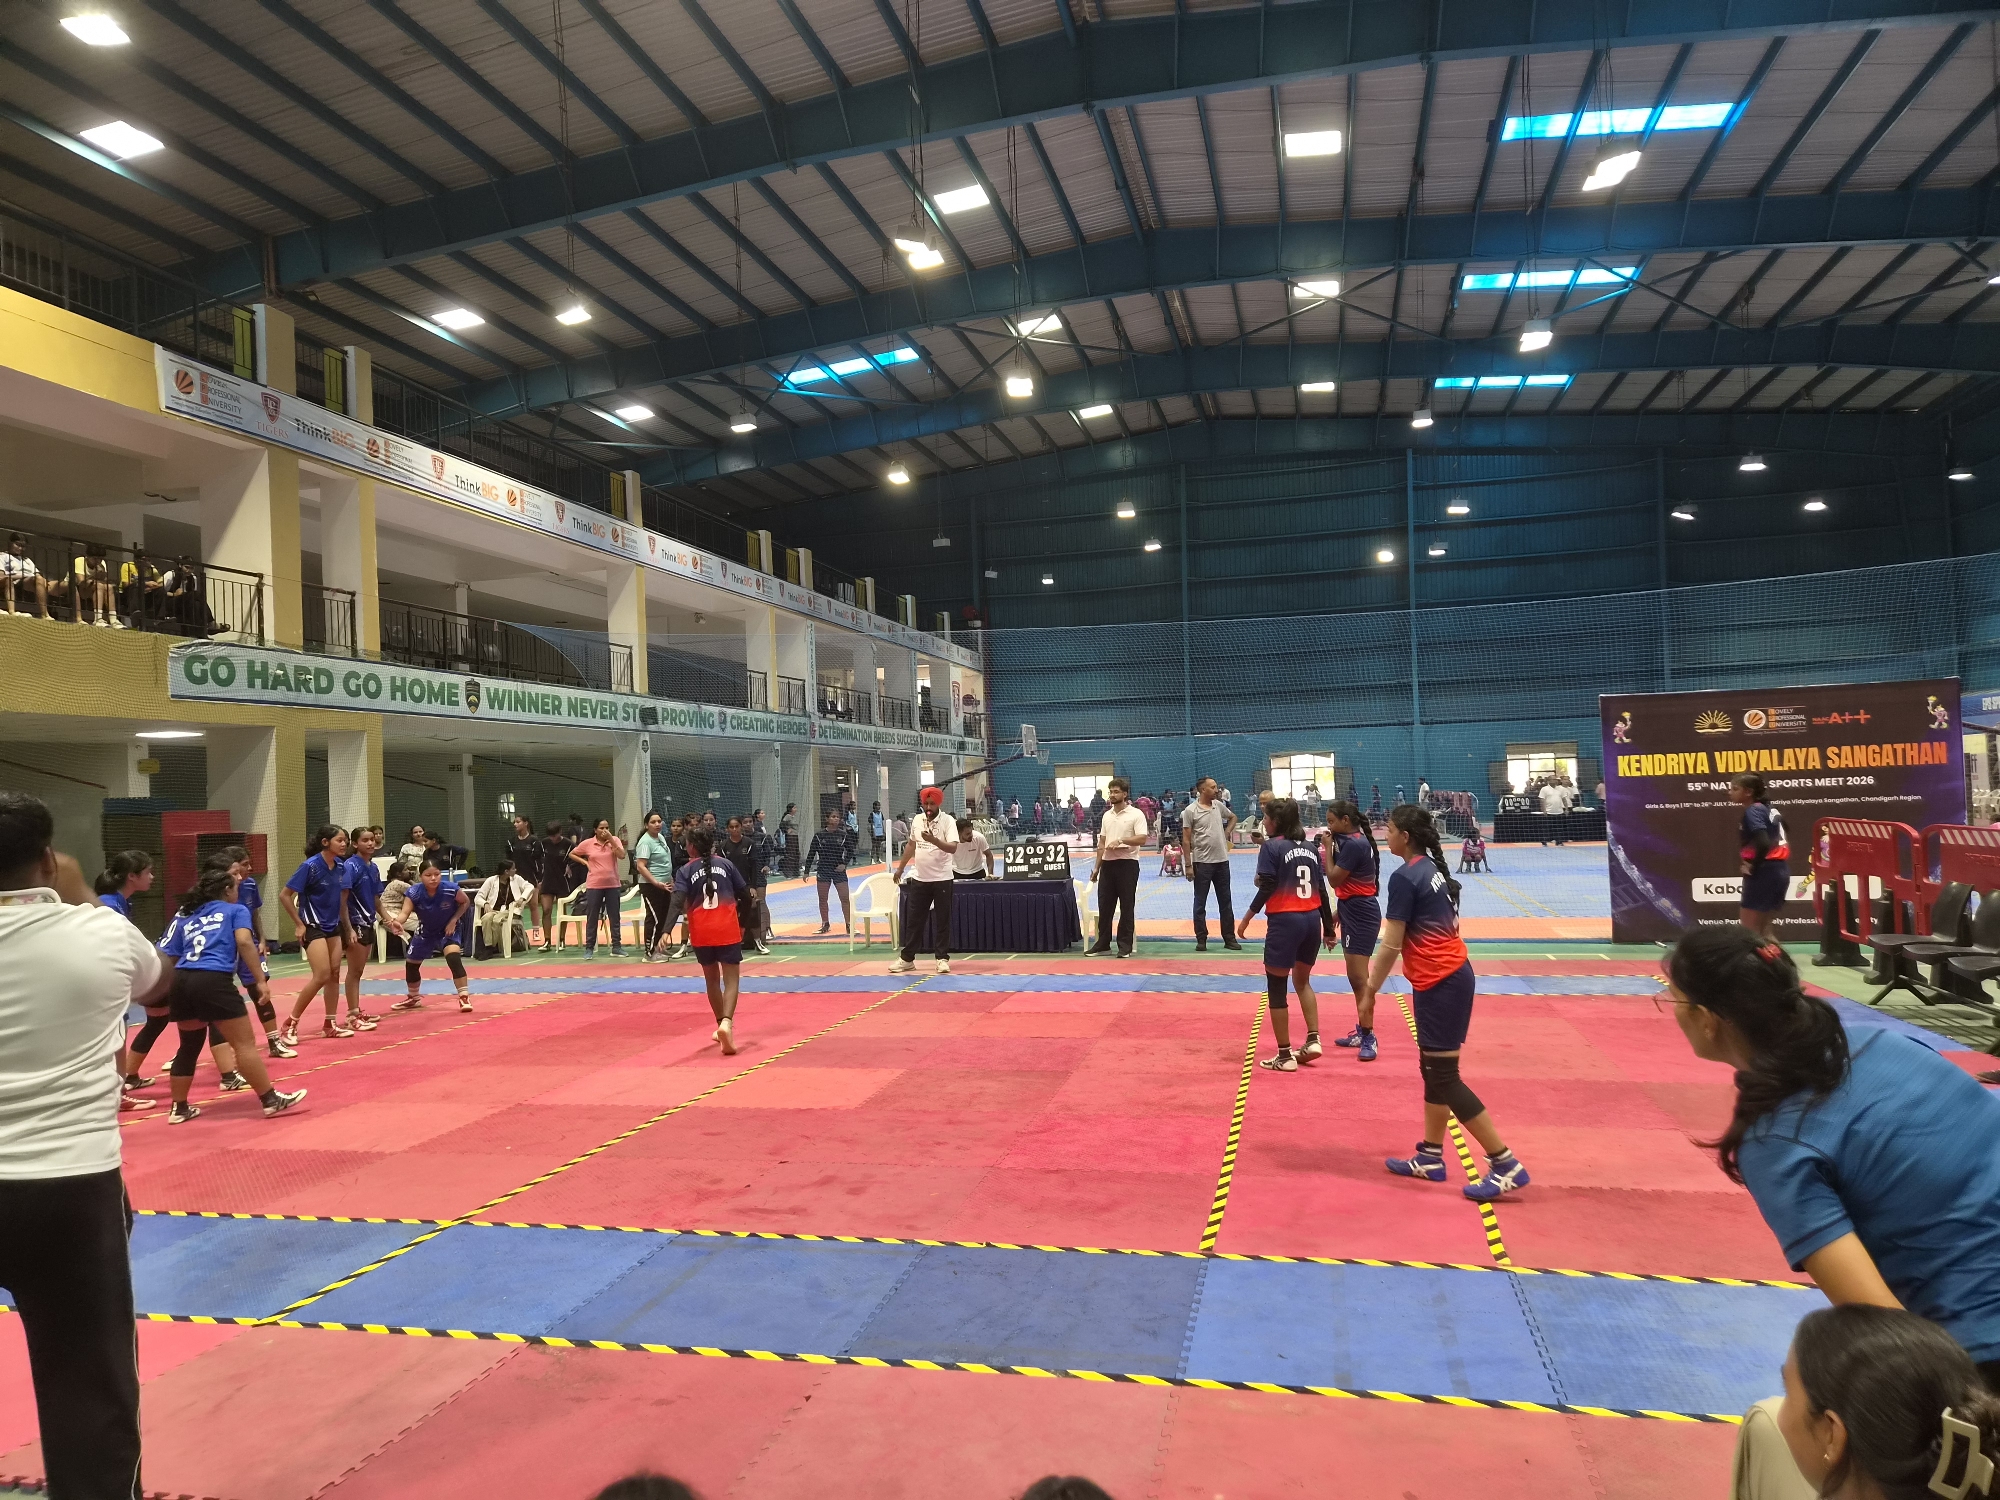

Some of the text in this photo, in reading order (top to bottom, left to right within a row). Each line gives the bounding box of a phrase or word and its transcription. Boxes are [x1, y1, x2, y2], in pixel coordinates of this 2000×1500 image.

[201, 395, 242, 414] UNIVERSITY
[255, 421, 289, 439] TIGERS
[183, 653, 236, 687] GO
[246, 658, 335, 695] HARD
[342, 669, 383, 700] GO
[389, 675, 460, 707] HOME
[485, 686, 563, 717] WINNER
[567, 696, 618, 721] NEVER
[661, 707, 715, 729] PROVING
[730, 714, 774, 734] CREATING
[776, 719, 808, 736] HEROES
[818, 724, 873, 742] DETERMINATION
[873, 730, 896, 746] BREEDS
[896, 733, 920, 747] SUCCESS
[1617, 752, 1709, 777] KENDRIYA
[1714, 747, 1821, 774] VIDYALAYA
[1826, 741, 1948, 768] SANGATHAN
[1687, 781, 1709, 791] 55th
[1768, 778, 1813, 788] SPORTS
[1814, 777, 1844, 787] MEET
[1846, 776, 1875, 785] 2026
[1791, 797, 1823, 806] Vidyalaya
[1823, 796, 1861, 804] Sangathan,
[1861, 794, 1899, 803] Chandigarh
[1900, 794, 1922, 802] Region
[1005, 846, 1025, 864] 32
[1046, 844, 1065, 862] 32
[1029, 857, 1043, 865] SET
[1007, 862, 1066, 873] HOME GUEST
[1296, 865, 1312, 899] 3
[1703, 883, 1743, 895] Kaba
[186, 934, 206, 962] 9
